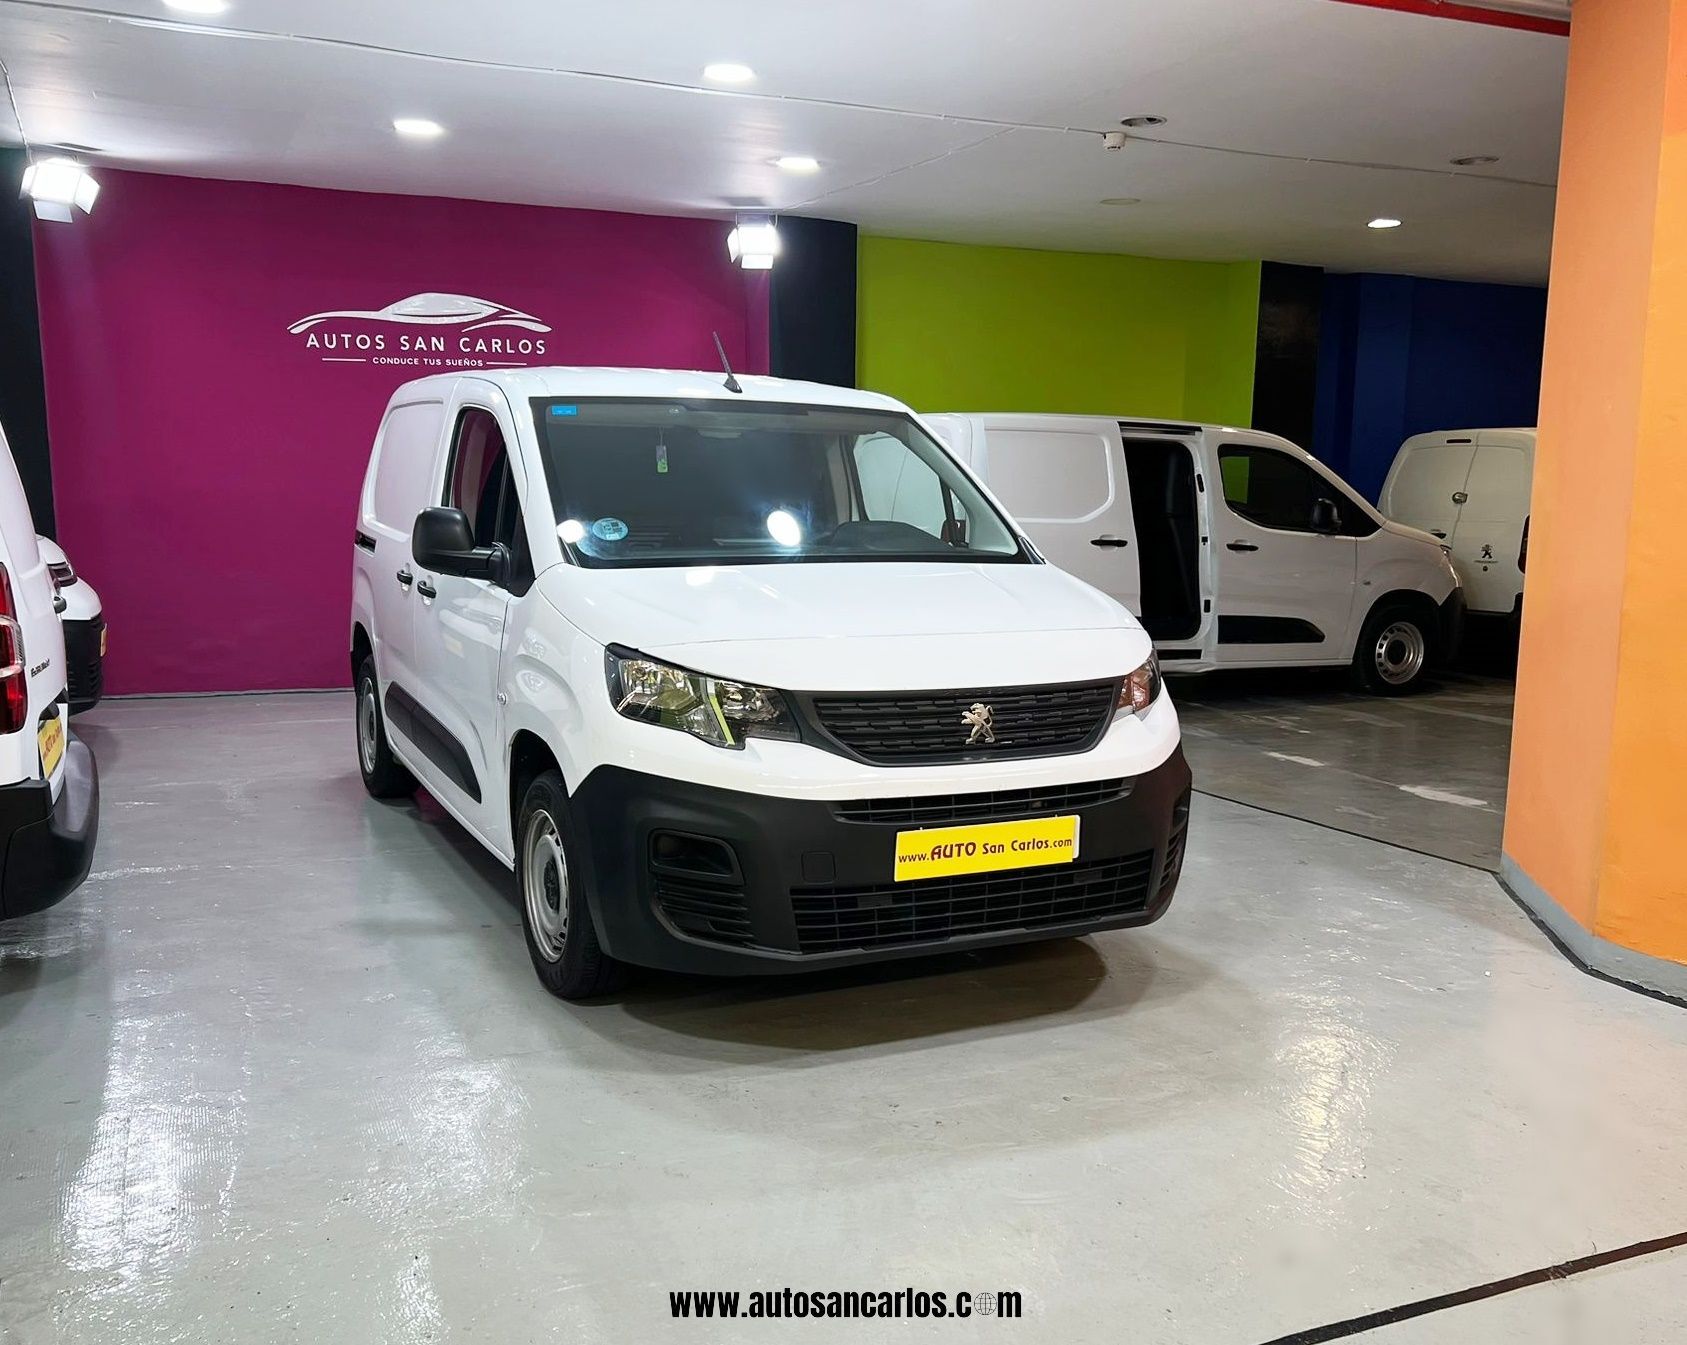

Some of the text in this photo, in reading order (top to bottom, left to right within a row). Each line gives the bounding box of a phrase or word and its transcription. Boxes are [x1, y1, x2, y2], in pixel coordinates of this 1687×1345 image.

[306, 333, 545, 354] AUTOS SAN CARLOS
[372, 357, 484, 367] CONDUCE TUS SUEÑOS
[982, 843, 1005, 855] San
[1011, 838, 1072, 852] Carlos.com
